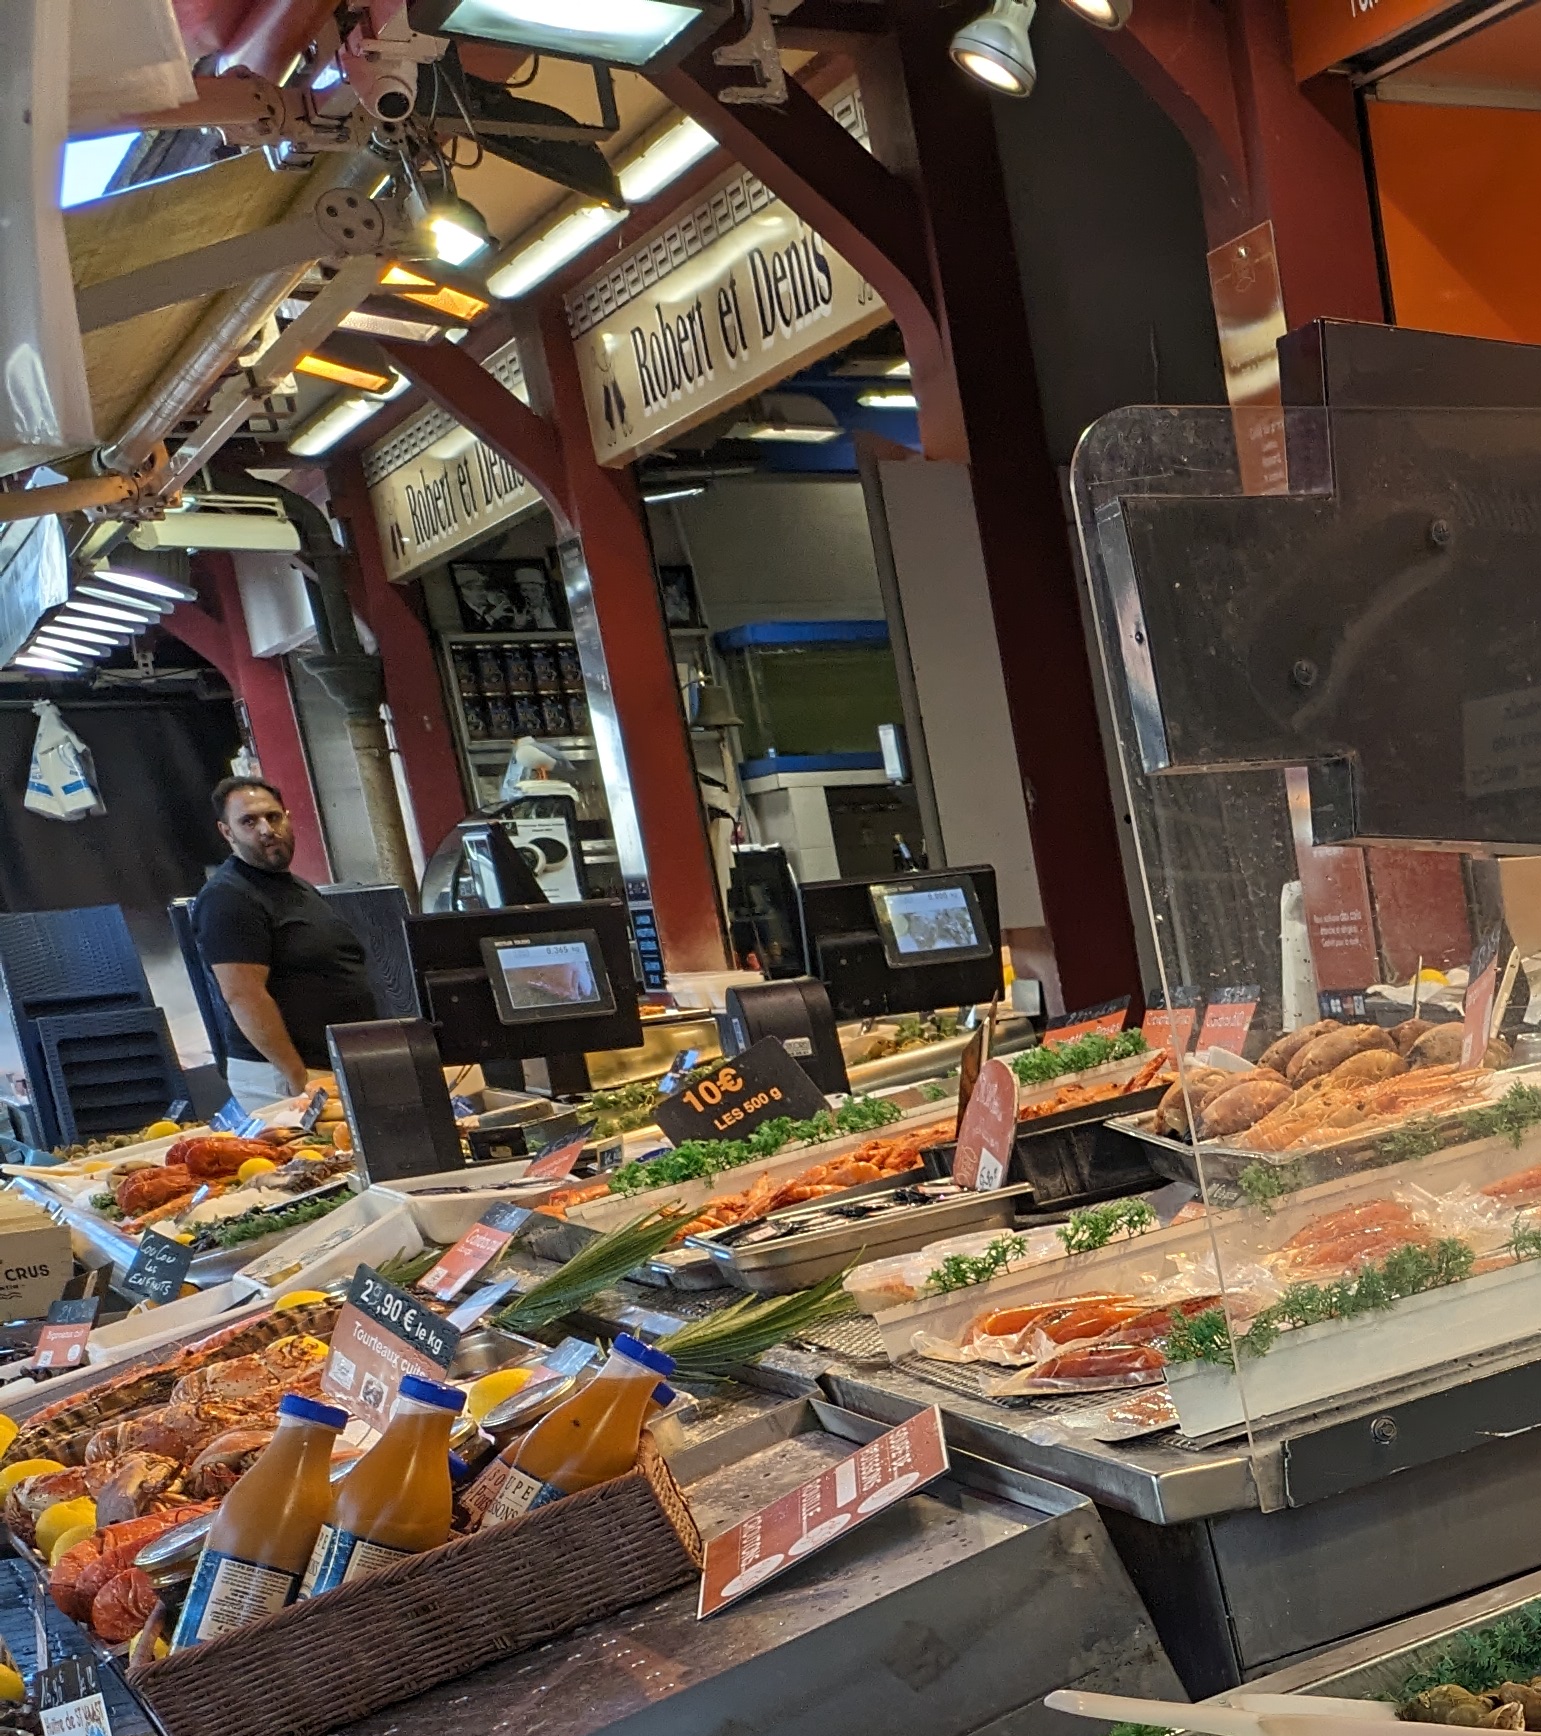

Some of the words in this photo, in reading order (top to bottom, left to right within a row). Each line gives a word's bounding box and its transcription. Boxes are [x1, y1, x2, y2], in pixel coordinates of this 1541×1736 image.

[630, 300, 717, 411] Robert
[717, 272, 749, 361] et
[746, 225, 834, 341] Denis
[406, 468, 458, 546] Robert
[458, 456, 480, 520] et
[683, 1066, 744, 1114] 10€
[713, 1107, 746, 1132] LES
[743, 1091, 770, 1115] 500
[769, 1085, 783, 1101] g
[5, 1264, 51, 1282] CRUS
[353, 1320, 400, 1368] Tourteaux
[403, 1308, 418, 1333] €
[415, 1321, 428, 1341] le
[427, 1329, 444, 1356] kg
[491, 1465, 536, 1502] SOUPE
[65, 1711, 75, 1730] de
